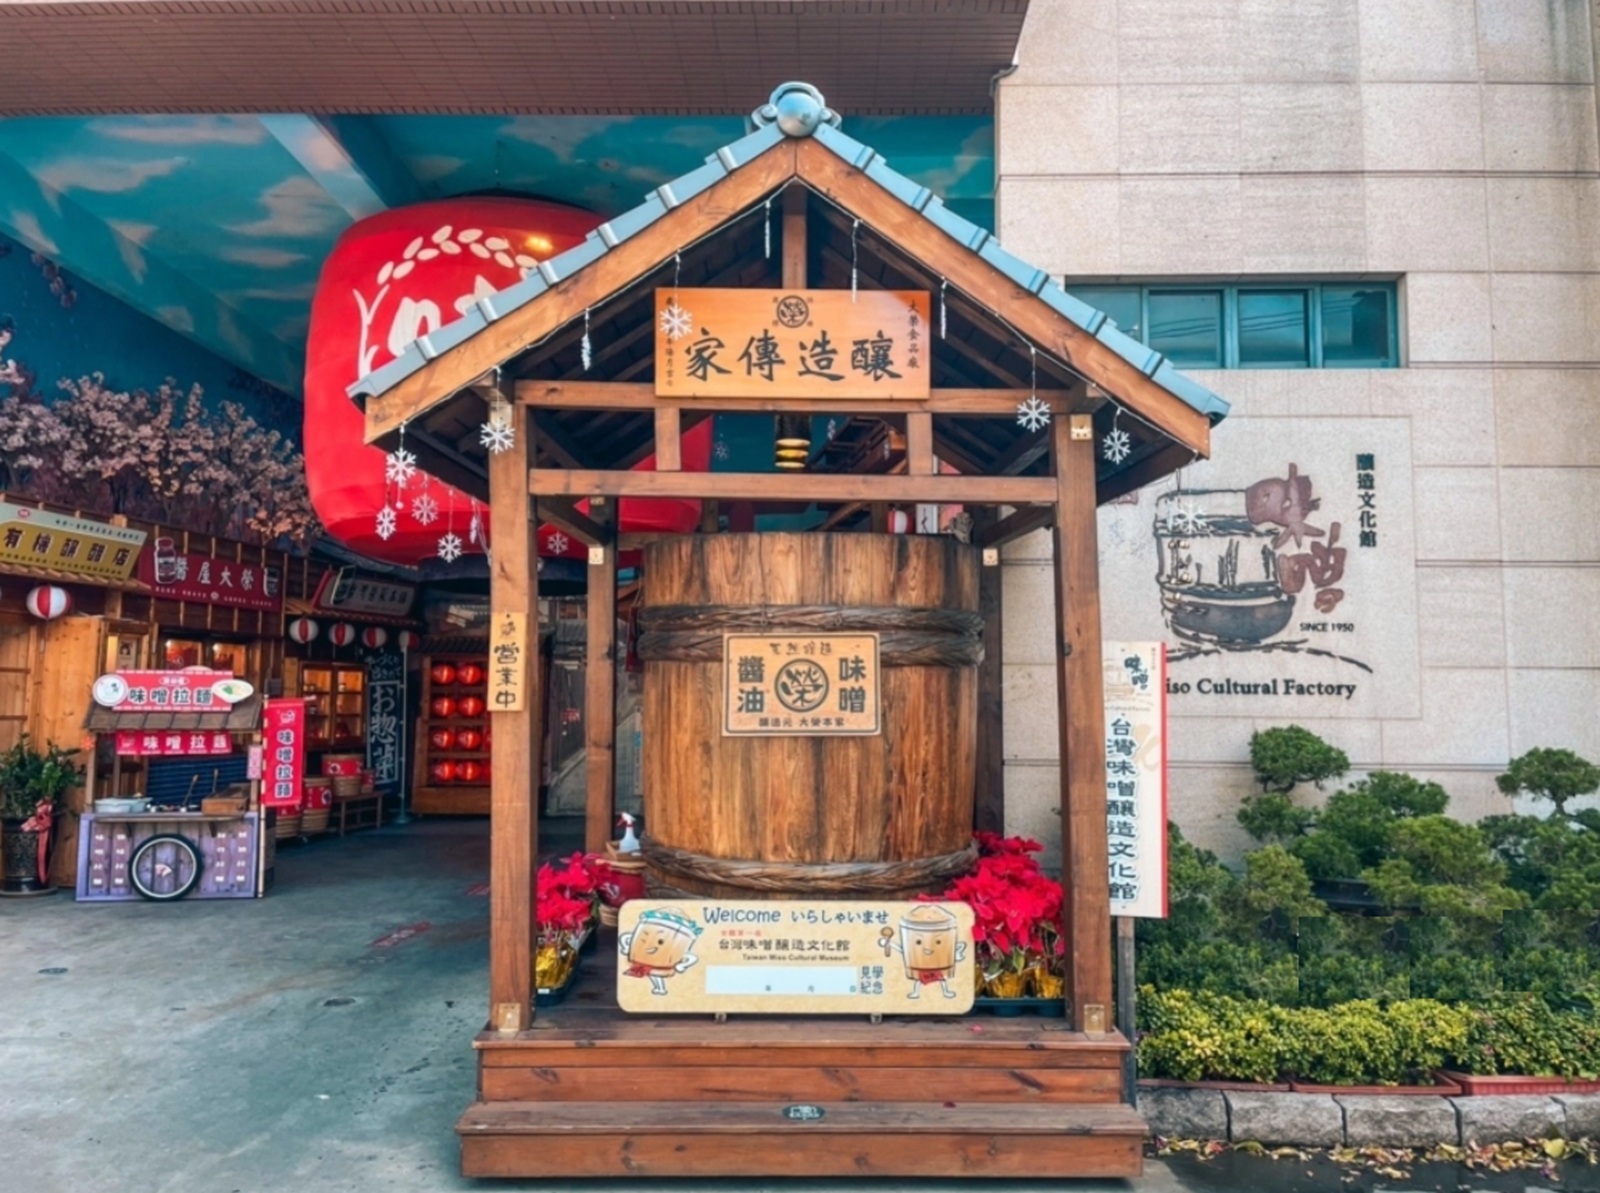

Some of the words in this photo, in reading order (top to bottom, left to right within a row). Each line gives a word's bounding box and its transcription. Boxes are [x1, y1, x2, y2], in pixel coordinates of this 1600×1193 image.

[1300, 622, 1329, 632] SINCE
[1331, 622, 1355, 633] 1950
[737, 655, 765, 713] 醬油
[839, 655, 866, 713] 味噌
[1166, 678, 1191, 695] iso
[1196, 677, 1279, 695] Cultural
[1283, 679, 1357, 700] Factory
[703, 906, 782, 925] Welcome
[791, 909, 890, 925] いらしゃいませ
[742, 953, 767, 961] Taiwan
[769, 953, 786, 961] Miso
[788, 953, 817, 961] Cultural
[819, 953, 850, 961] Museum
[860, 965, 884, 980] 見學
[860, 981, 884, 995] 紀念
